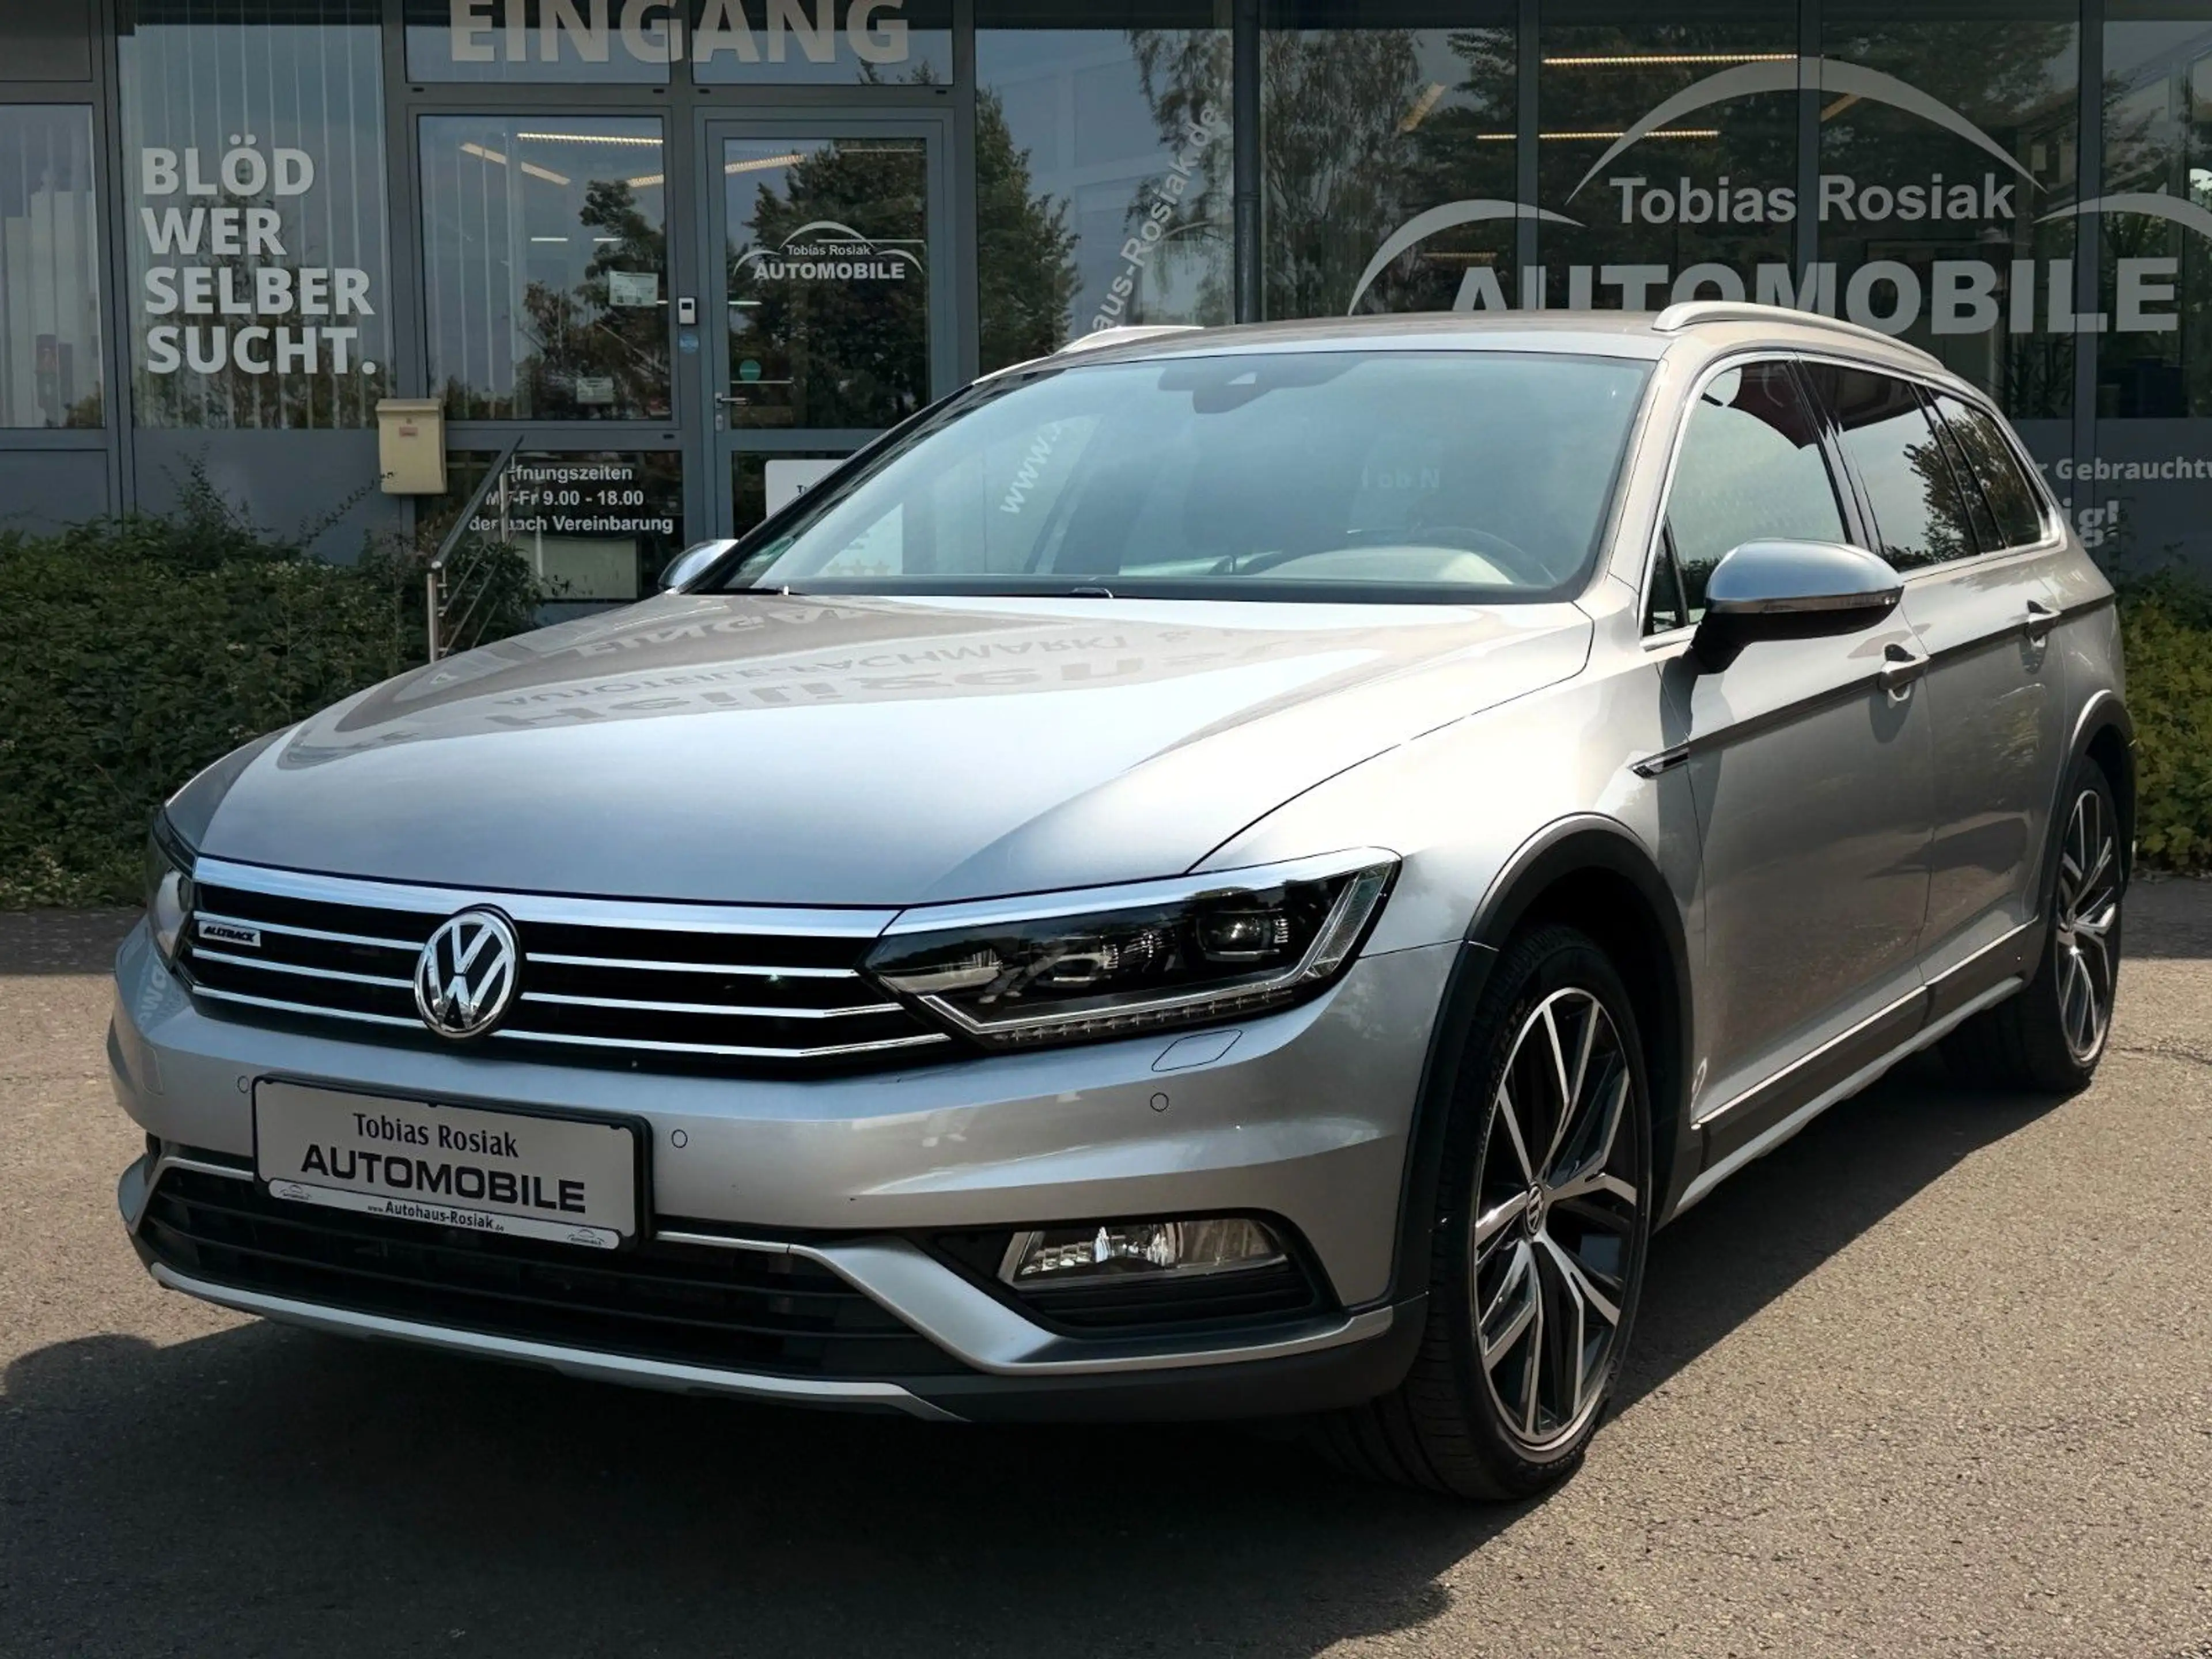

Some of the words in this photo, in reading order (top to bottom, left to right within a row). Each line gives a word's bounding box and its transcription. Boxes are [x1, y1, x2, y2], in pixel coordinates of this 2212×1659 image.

[451, 0, 909, 63] EINGANG
[142, 134, 315, 196] BLÖD
[1609, 176, 1797, 224] Tobias
[1819, 173, 2016, 222] Rosiak
[141, 207, 287, 255] WER
[786, 244, 826, 256] Tobias
[829, 244, 871, 256] Rosiak
[145, 267, 376, 315] SELBER
[753, 263, 906, 279] AUTOMOBILE
[1452, 257, 2179, 335] AUTOMOBILE
[146, 326, 376, 374] SUCHT.
[2055, 456, 2212, 480] Gebraucht
[543, 490, 580, 506] 9.00
[597, 490, 644, 506] 18.00
[552, 516, 673, 535] Vereinbarung
[353, 1112, 429, 1146] Tobias
[438, 1124, 519, 1158] Rosiak
[301, 1143, 586, 1214] AUTOMOBILE
